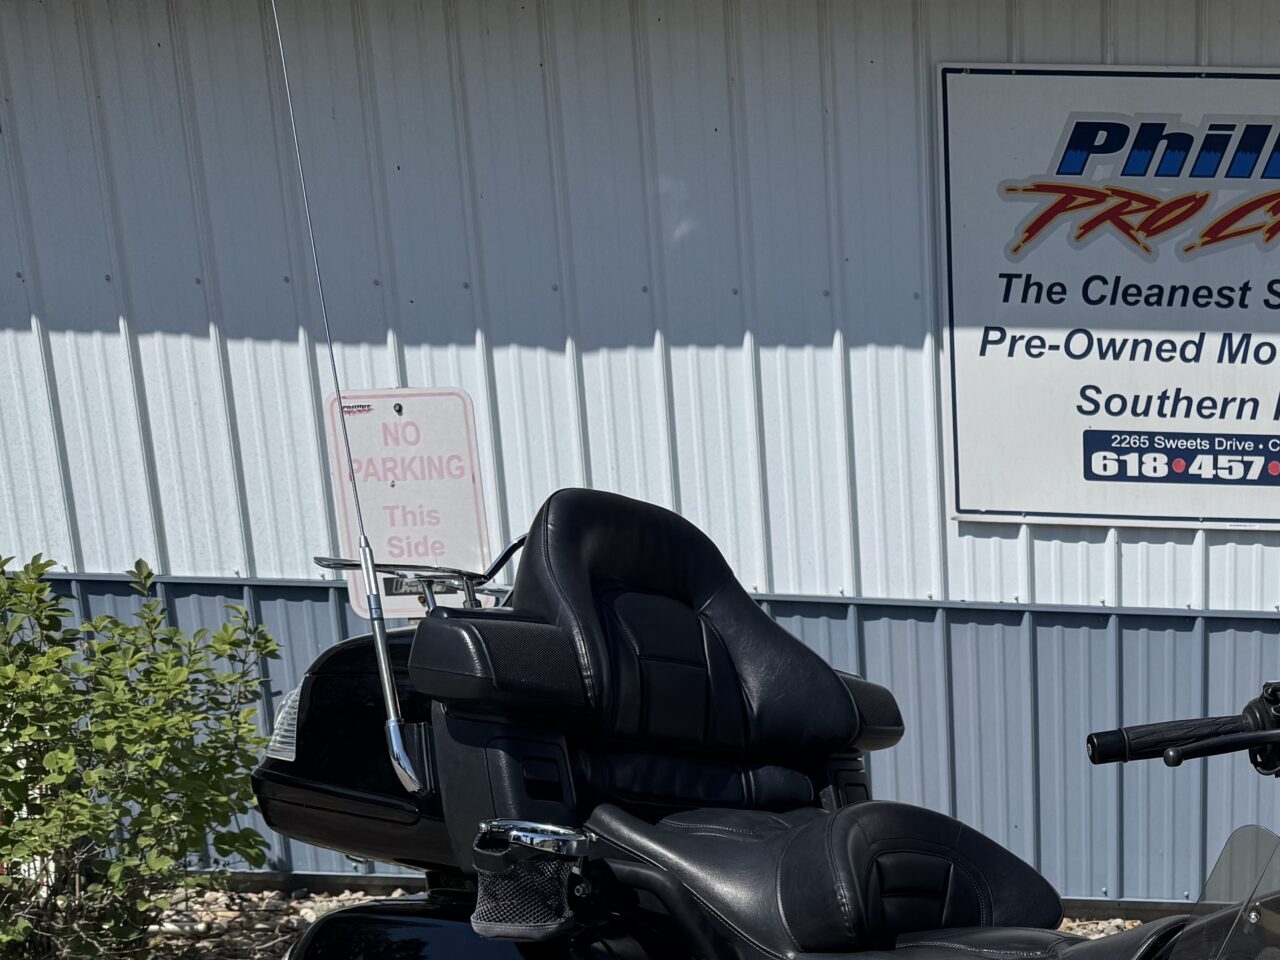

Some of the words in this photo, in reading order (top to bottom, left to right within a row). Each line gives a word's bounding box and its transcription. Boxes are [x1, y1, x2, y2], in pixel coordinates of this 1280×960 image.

[1005, 183, 1208, 254] PRO
[998, 273, 1067, 304] The
[1081, 276, 1251, 309] Cleanest
[979, 327, 1205, 363] Pre-Owned
[1076, 385, 1259, 420] Southern
[382, 421, 421, 447] NO
[1111, 434, 1148, 450] 2265
[1153, 436, 1210, 451] Sweets
[1214, 438, 1254, 451] Drive
[349, 455, 465, 482] PARKING
[383, 505, 441, 528] This
[387, 536, 445, 559] Side
